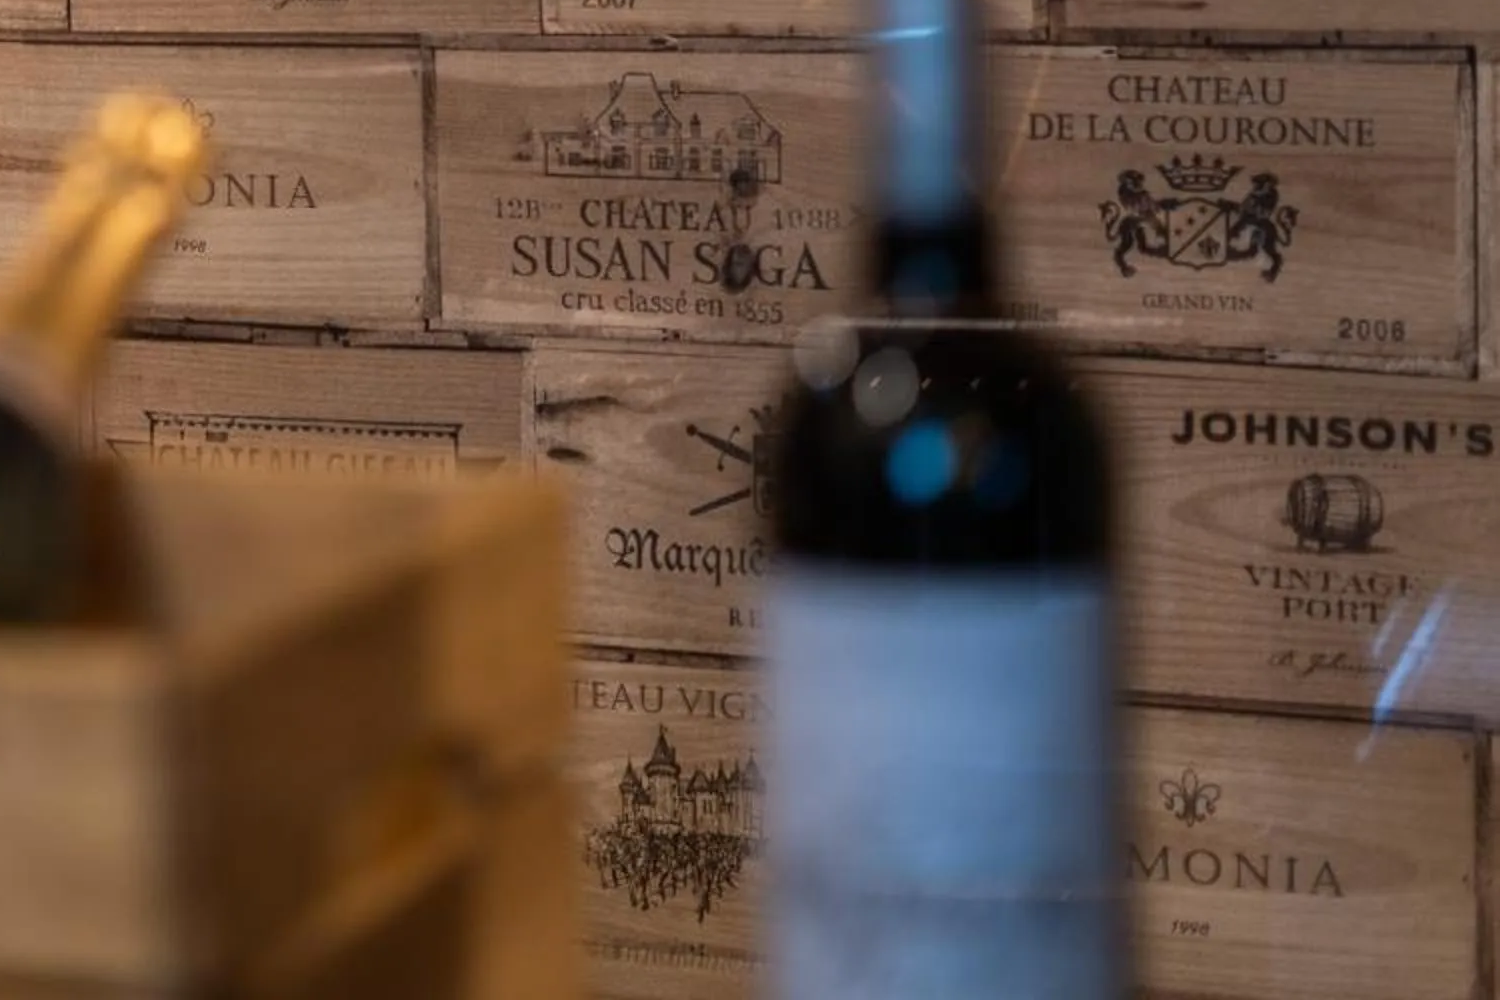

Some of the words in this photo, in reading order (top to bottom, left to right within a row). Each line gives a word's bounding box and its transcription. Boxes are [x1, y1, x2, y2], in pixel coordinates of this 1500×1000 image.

[1107, 73, 1289, 106] CHATEAU
[1028, 112, 1074, 140] DE
[1088, 113, 1130, 142] LA
[1144, 115, 1376, 148] COURONNE
[184, 173, 316, 208] ONIA
[580, 200, 752, 231] CHATEAU
[511, 234, 673, 282] SUSAN
[561, 289, 603, 310] cru
[614, 288, 687, 313] classé
[694, 294, 724, 318] en
[1141, 293, 1214, 310] GRAND
[1218, 295, 1253, 312] VIN
[1172, 409, 1494, 457] JOHNSON'S
[606, 527, 766, 586] Marquê
[1244, 563, 1419, 596] VINTAGE
[1282, 596, 1387, 623] PORT
[573, 680, 664, 713] TEAU
[1124, 843, 1344, 898] MONIA
